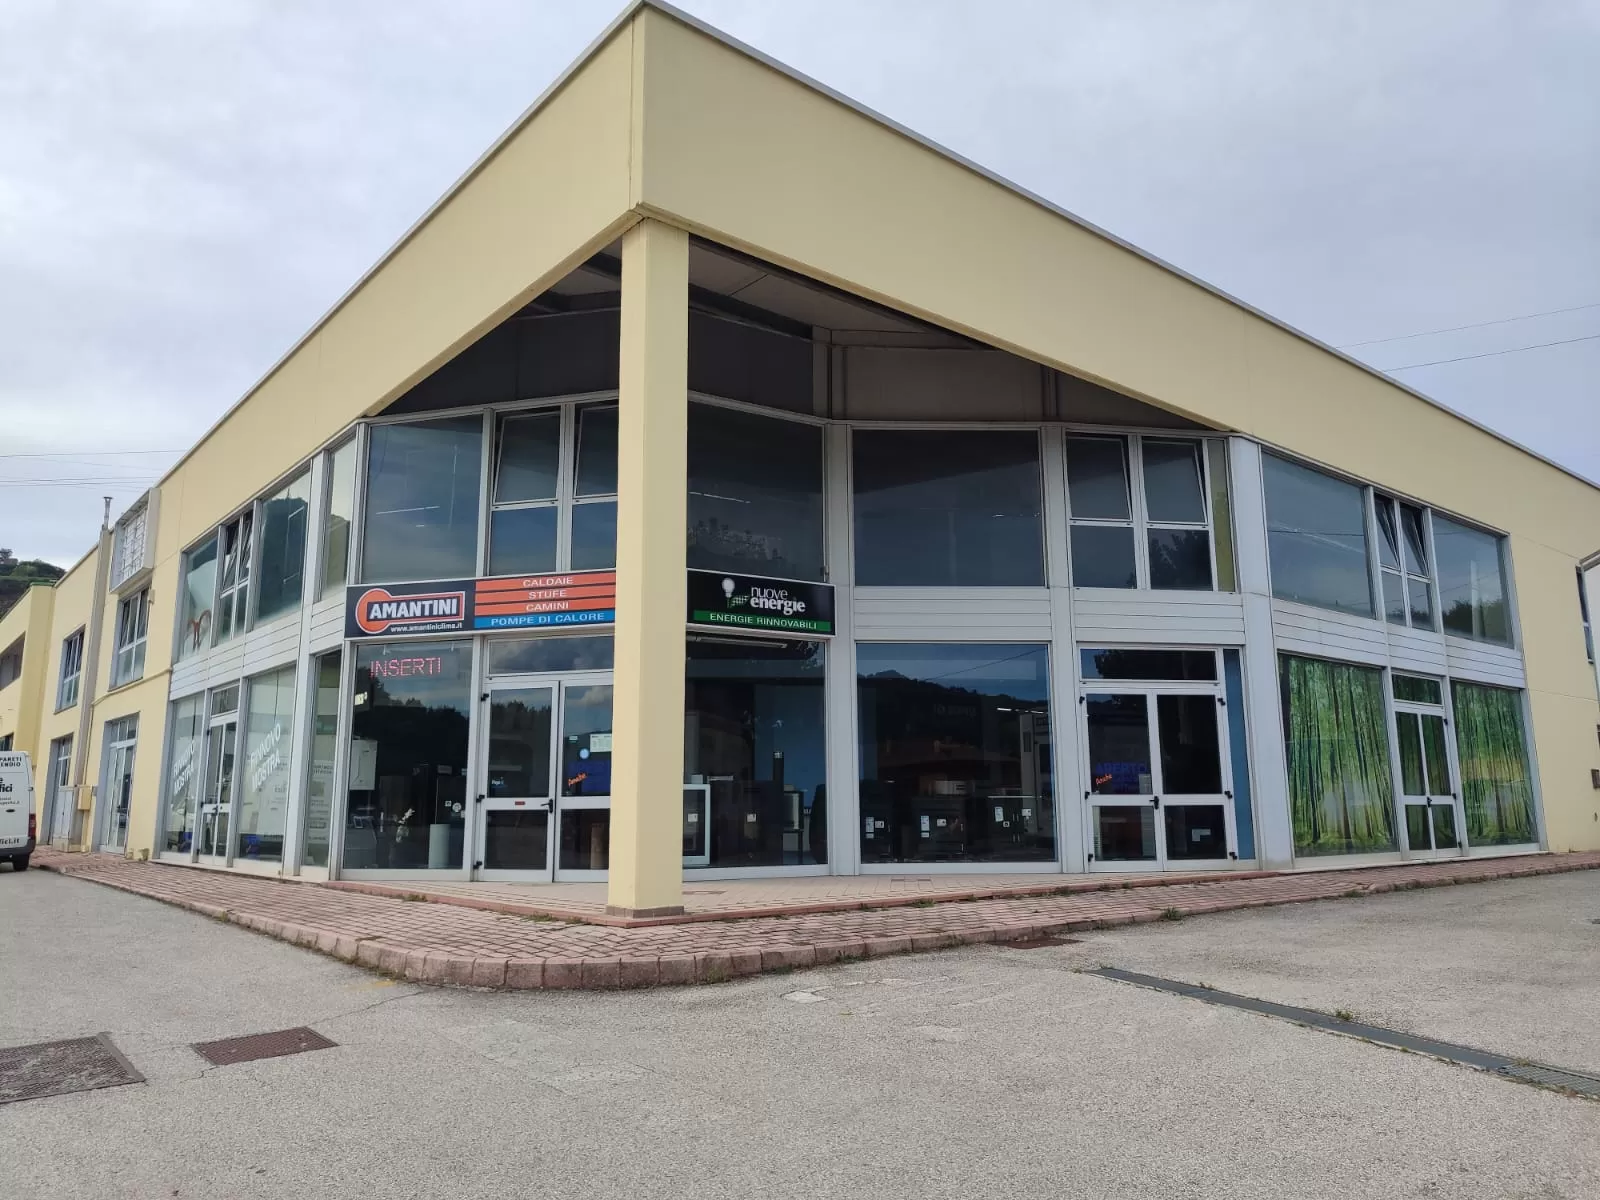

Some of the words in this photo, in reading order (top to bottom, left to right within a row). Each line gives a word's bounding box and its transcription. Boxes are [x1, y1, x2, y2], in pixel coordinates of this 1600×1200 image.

[522, 577, 574, 588] CALDAIE
[528, 589, 568, 600] STUFE
[751, 586, 788, 600] nuove
[369, 598, 458, 620] AMANTINI
[526, 602, 569, 612] CAMINI
[750, 596, 806, 615] energie
[491, 616, 534, 626] POMPE
[539, 615, 551, 624] DI
[555, 612, 605, 623] CALORE
[710, 613, 753, 624] ENERGIE
[756, 617, 817, 629] RINNOVABILI
[370, 657, 441, 677] INSERTI
